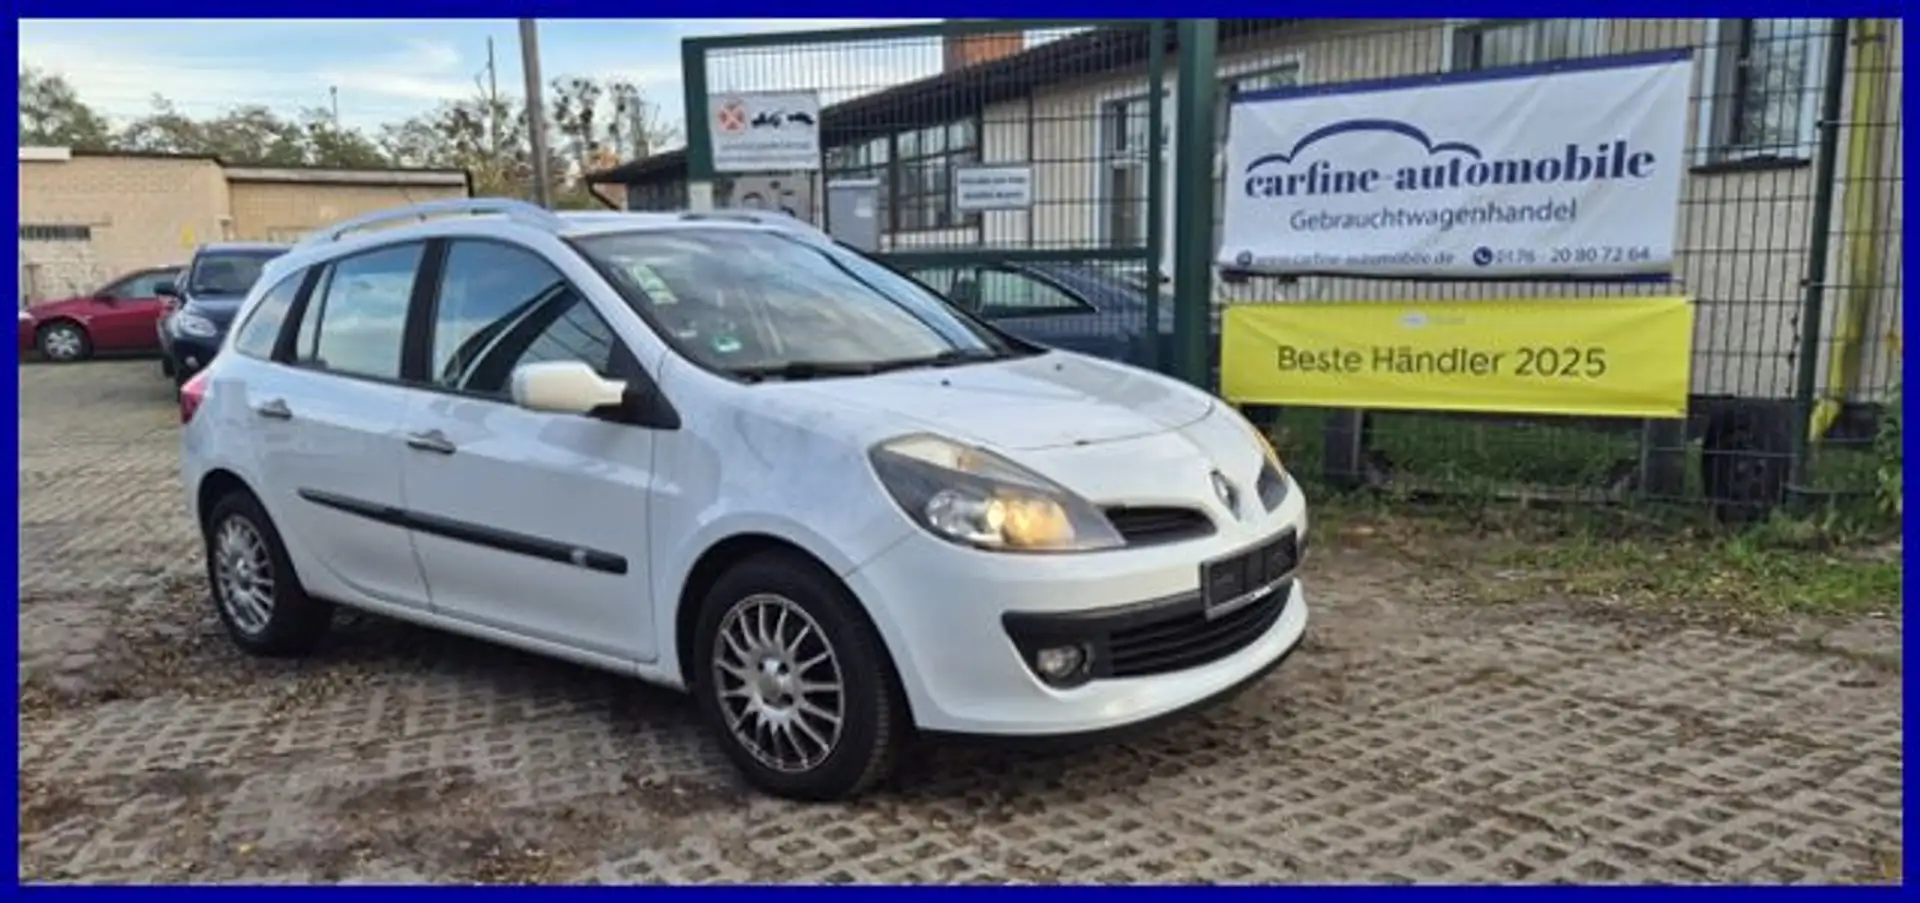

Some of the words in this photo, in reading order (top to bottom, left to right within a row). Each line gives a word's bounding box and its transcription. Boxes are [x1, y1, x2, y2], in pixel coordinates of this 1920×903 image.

[1244, 141, 1656, 197] carfine-automobile
[1290, 199, 1577, 231] Gebrauchtwagenhandel
[1278, 346, 1362, 374] Beste
[1372, 346, 1504, 376] Händler
[1515, 347, 1606, 378] 2025
